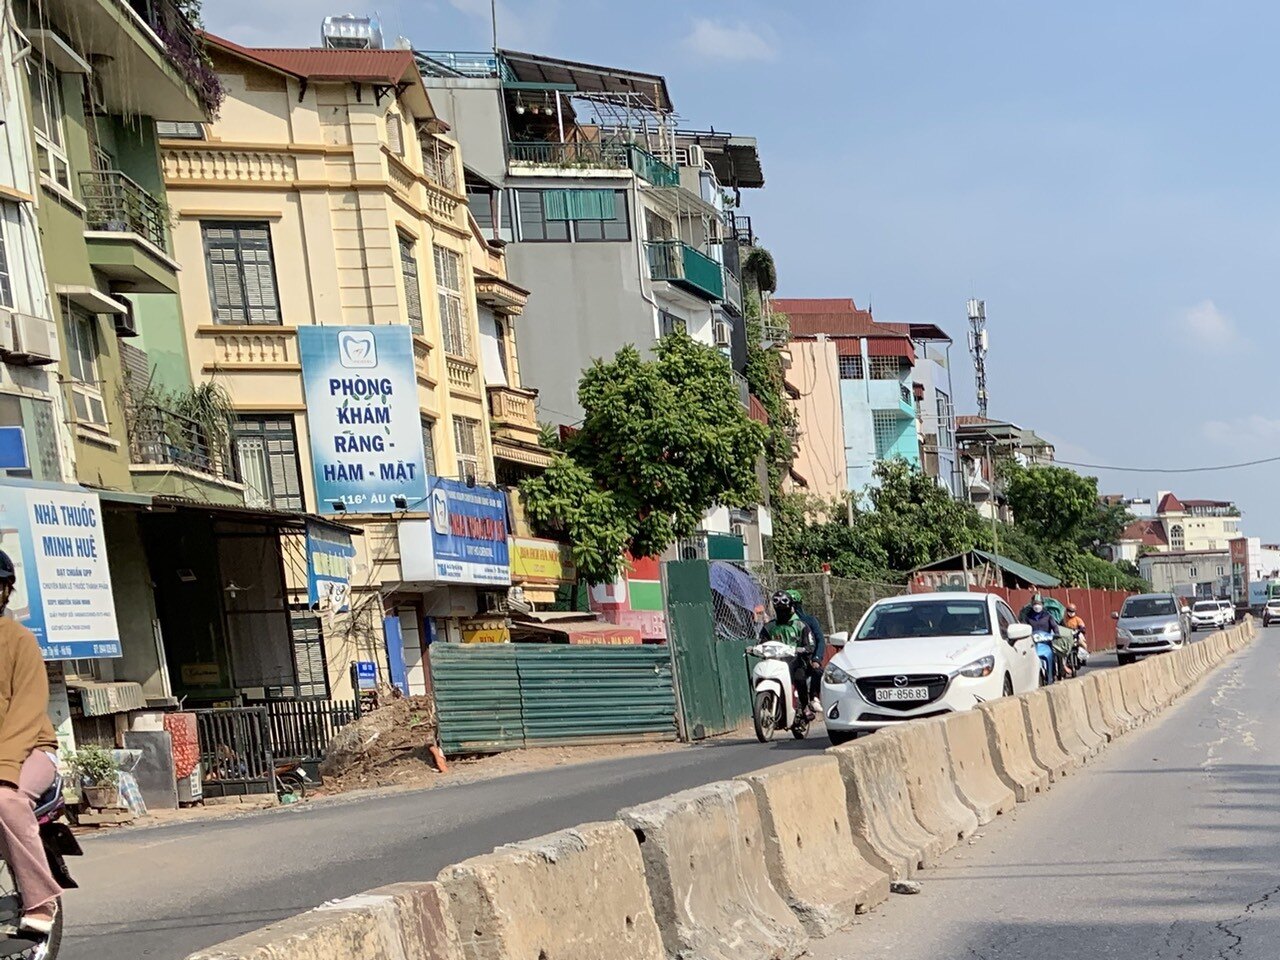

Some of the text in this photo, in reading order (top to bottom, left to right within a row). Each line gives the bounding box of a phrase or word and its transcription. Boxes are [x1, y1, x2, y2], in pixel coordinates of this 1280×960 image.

[329, 374, 393, 396] PHÒNG
[337, 403, 391, 425] KHÁM
[334, 431, 385, 453] RĂNG
[323, 460, 364, 482] HÀM
[380, 460, 416, 485] MẶT
[33, 500, 97, 528] NHÀ THUỐC
[42, 534, 98, 562] MINH HUỆ
